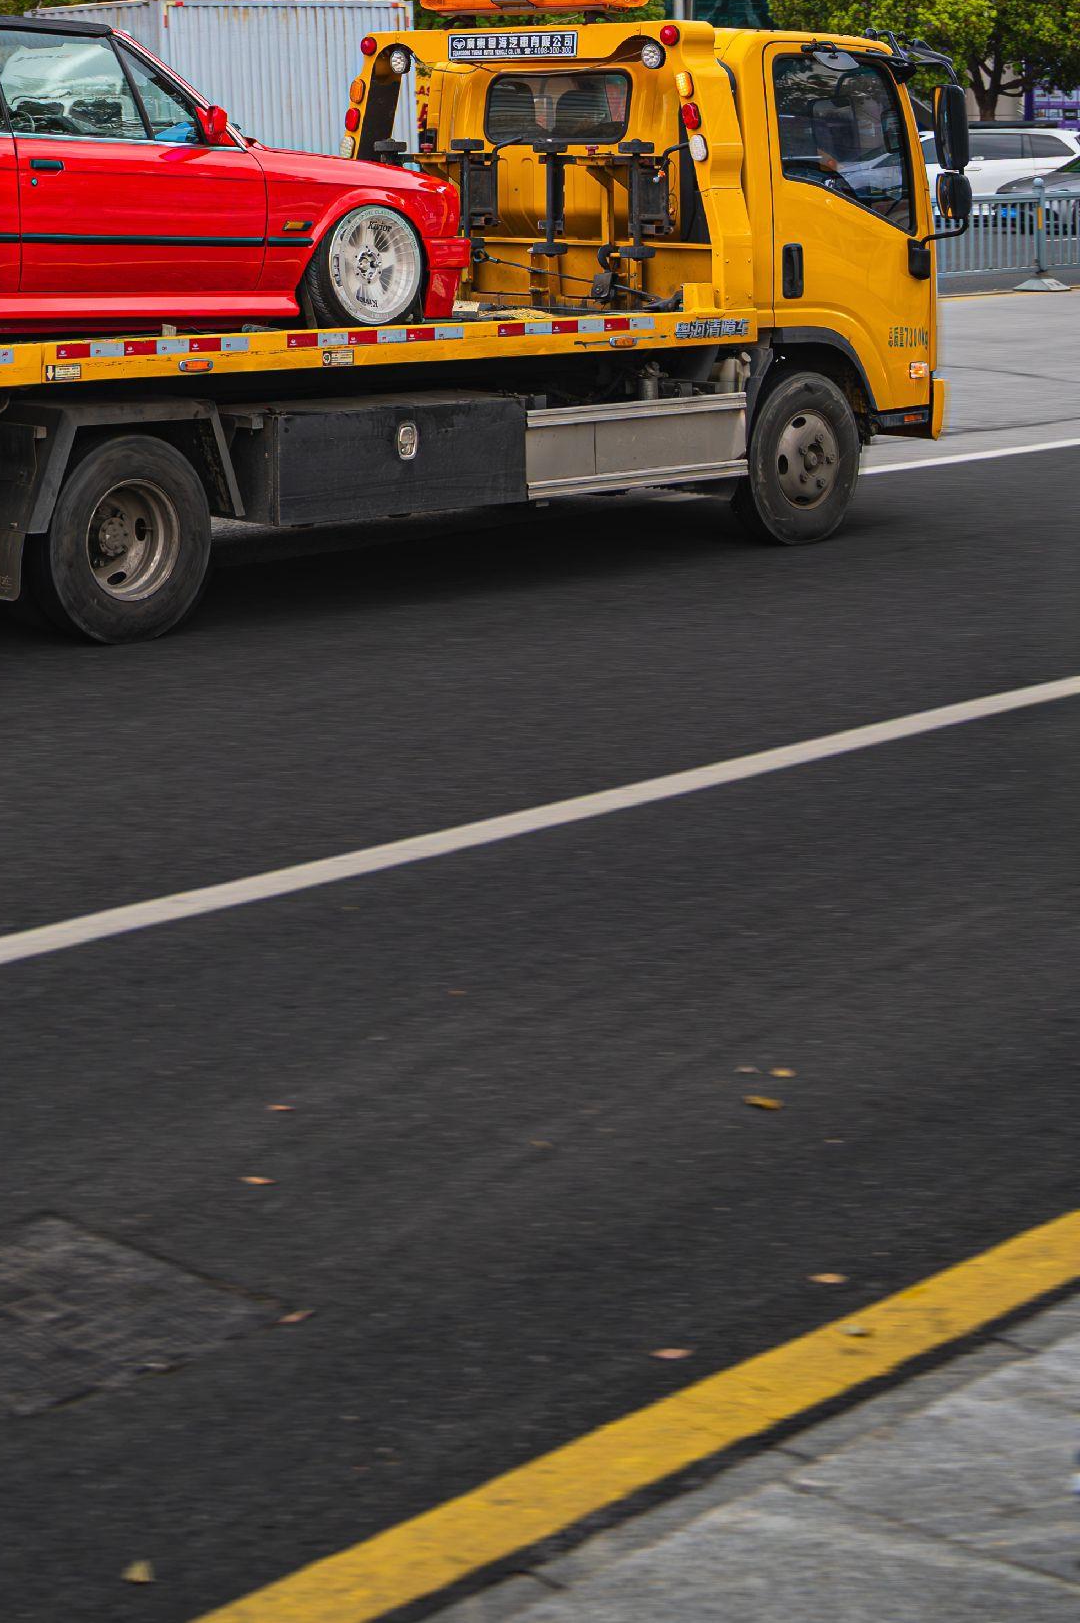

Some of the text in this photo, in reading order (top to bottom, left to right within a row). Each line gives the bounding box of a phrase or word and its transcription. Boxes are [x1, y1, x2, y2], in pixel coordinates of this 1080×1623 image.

[367, 220, 393, 232] Kivior
[675, 318, 750, 339] 粤海清障车
